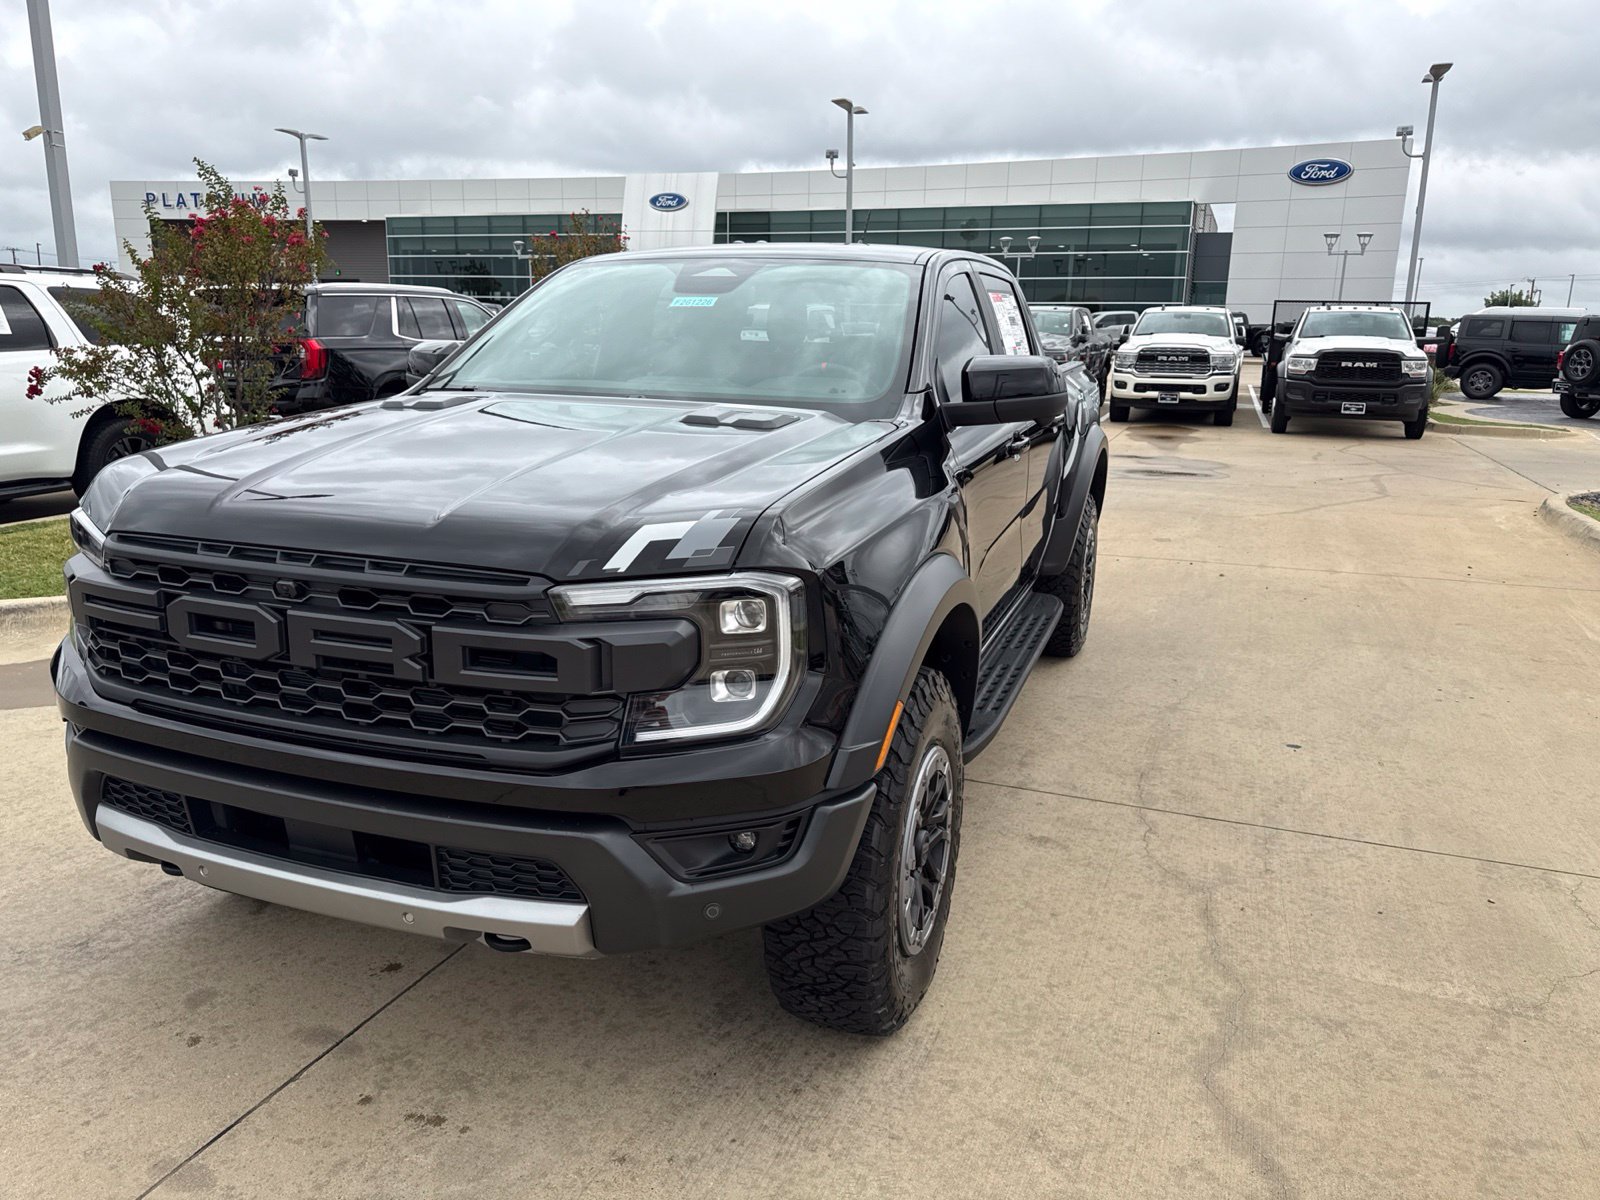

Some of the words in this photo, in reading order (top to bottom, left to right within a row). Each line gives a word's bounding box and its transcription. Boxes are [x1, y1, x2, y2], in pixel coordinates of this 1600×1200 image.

[1301, 164, 1338, 179] Ford
[656, 195, 678, 206] Ford
[69, 570, 601, 694] FORD
